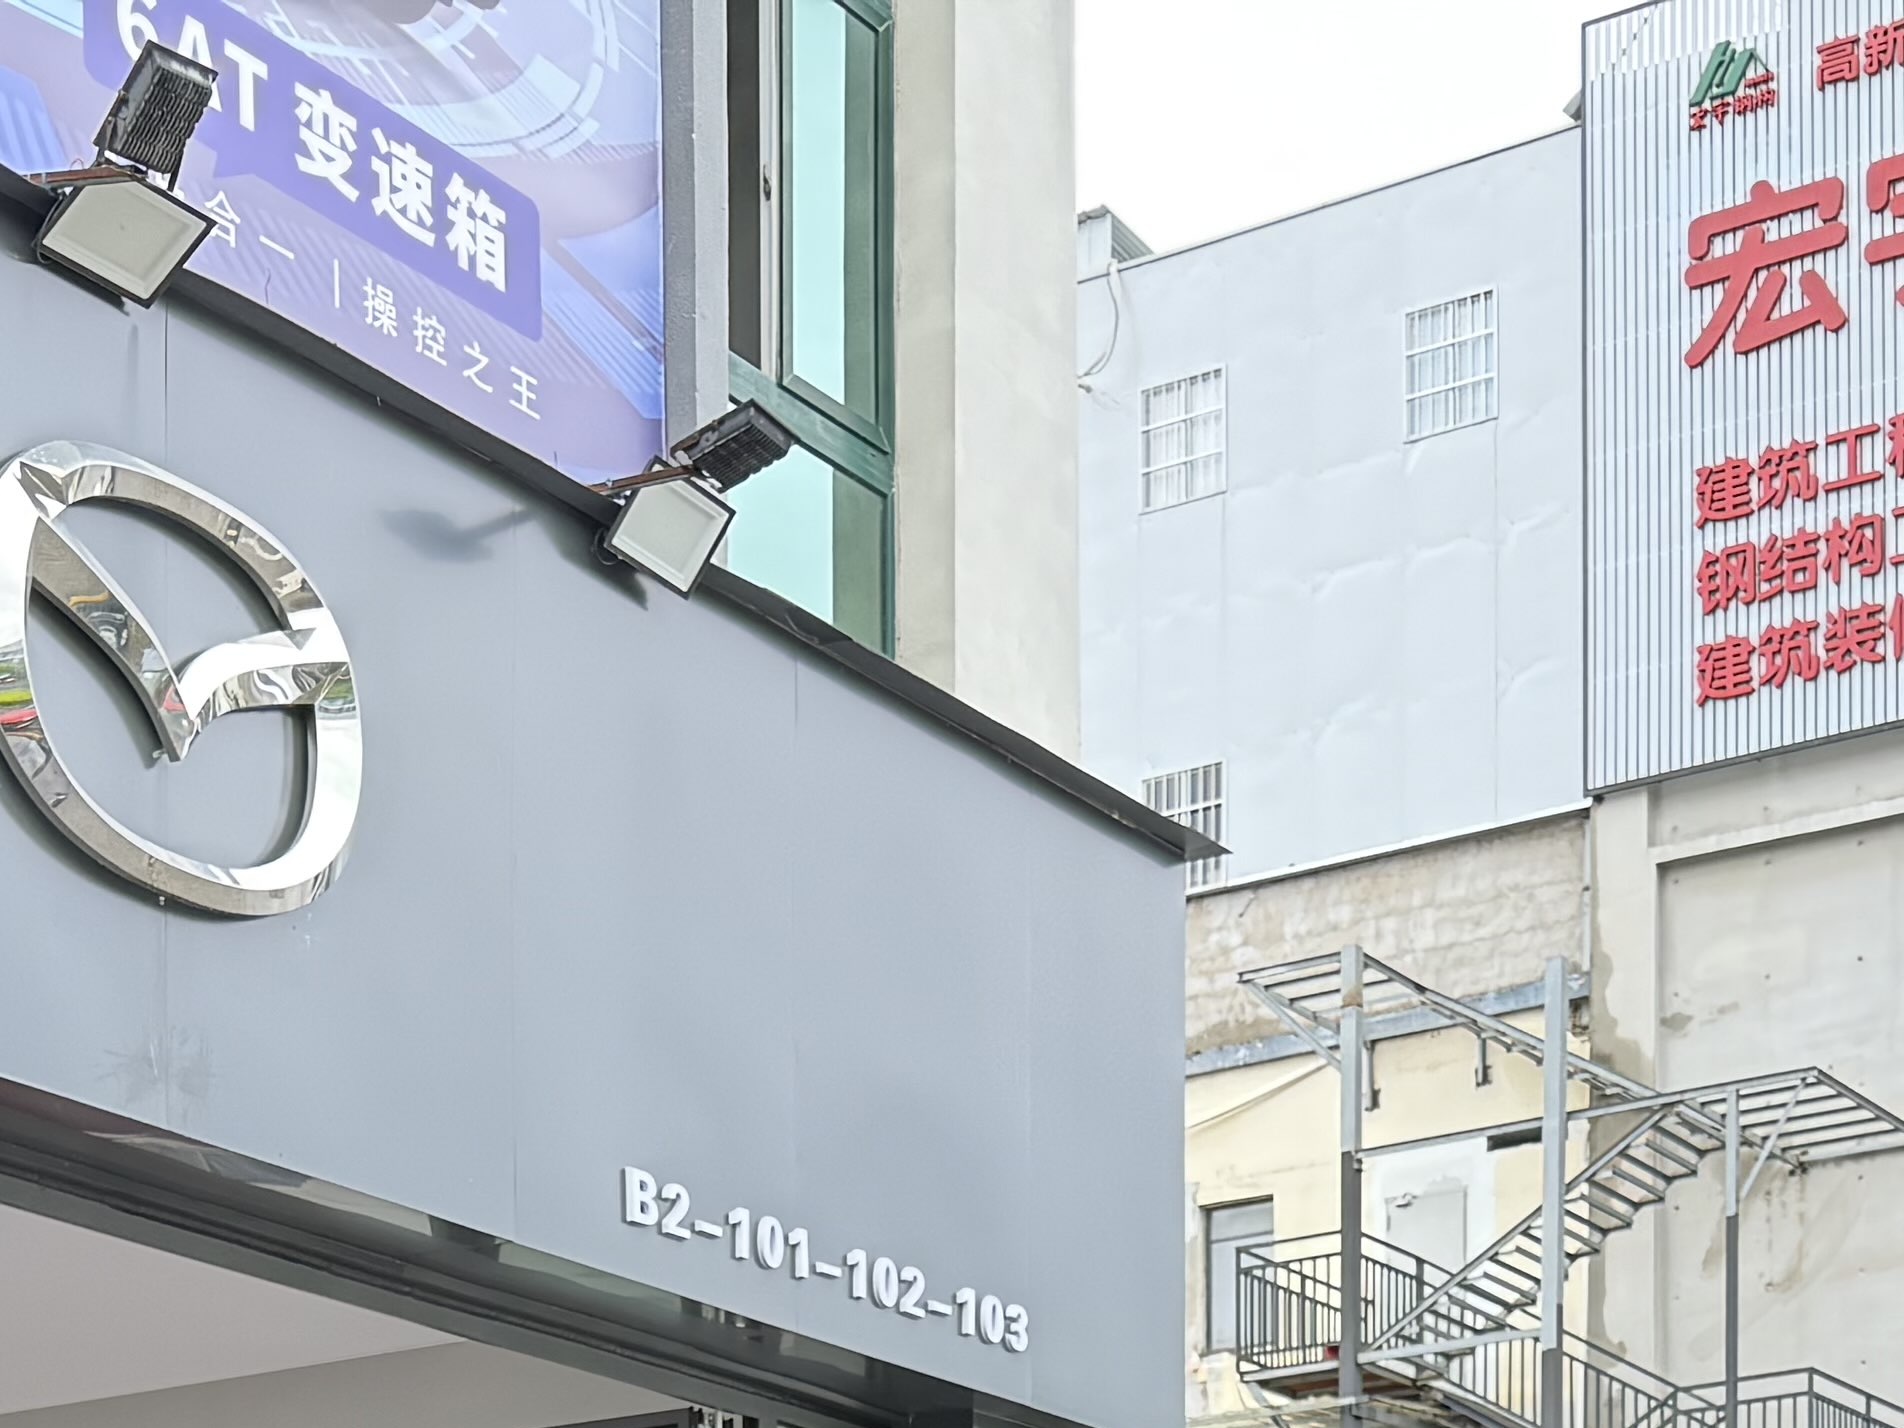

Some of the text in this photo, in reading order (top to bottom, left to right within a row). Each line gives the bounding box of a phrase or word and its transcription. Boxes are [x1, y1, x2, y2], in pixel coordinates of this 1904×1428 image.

[294, 80, 508, 294] 变速箱
[363, 276, 541, 421] 操控之王
[621, 1165, 1029, 1354] B2-101-102-103
